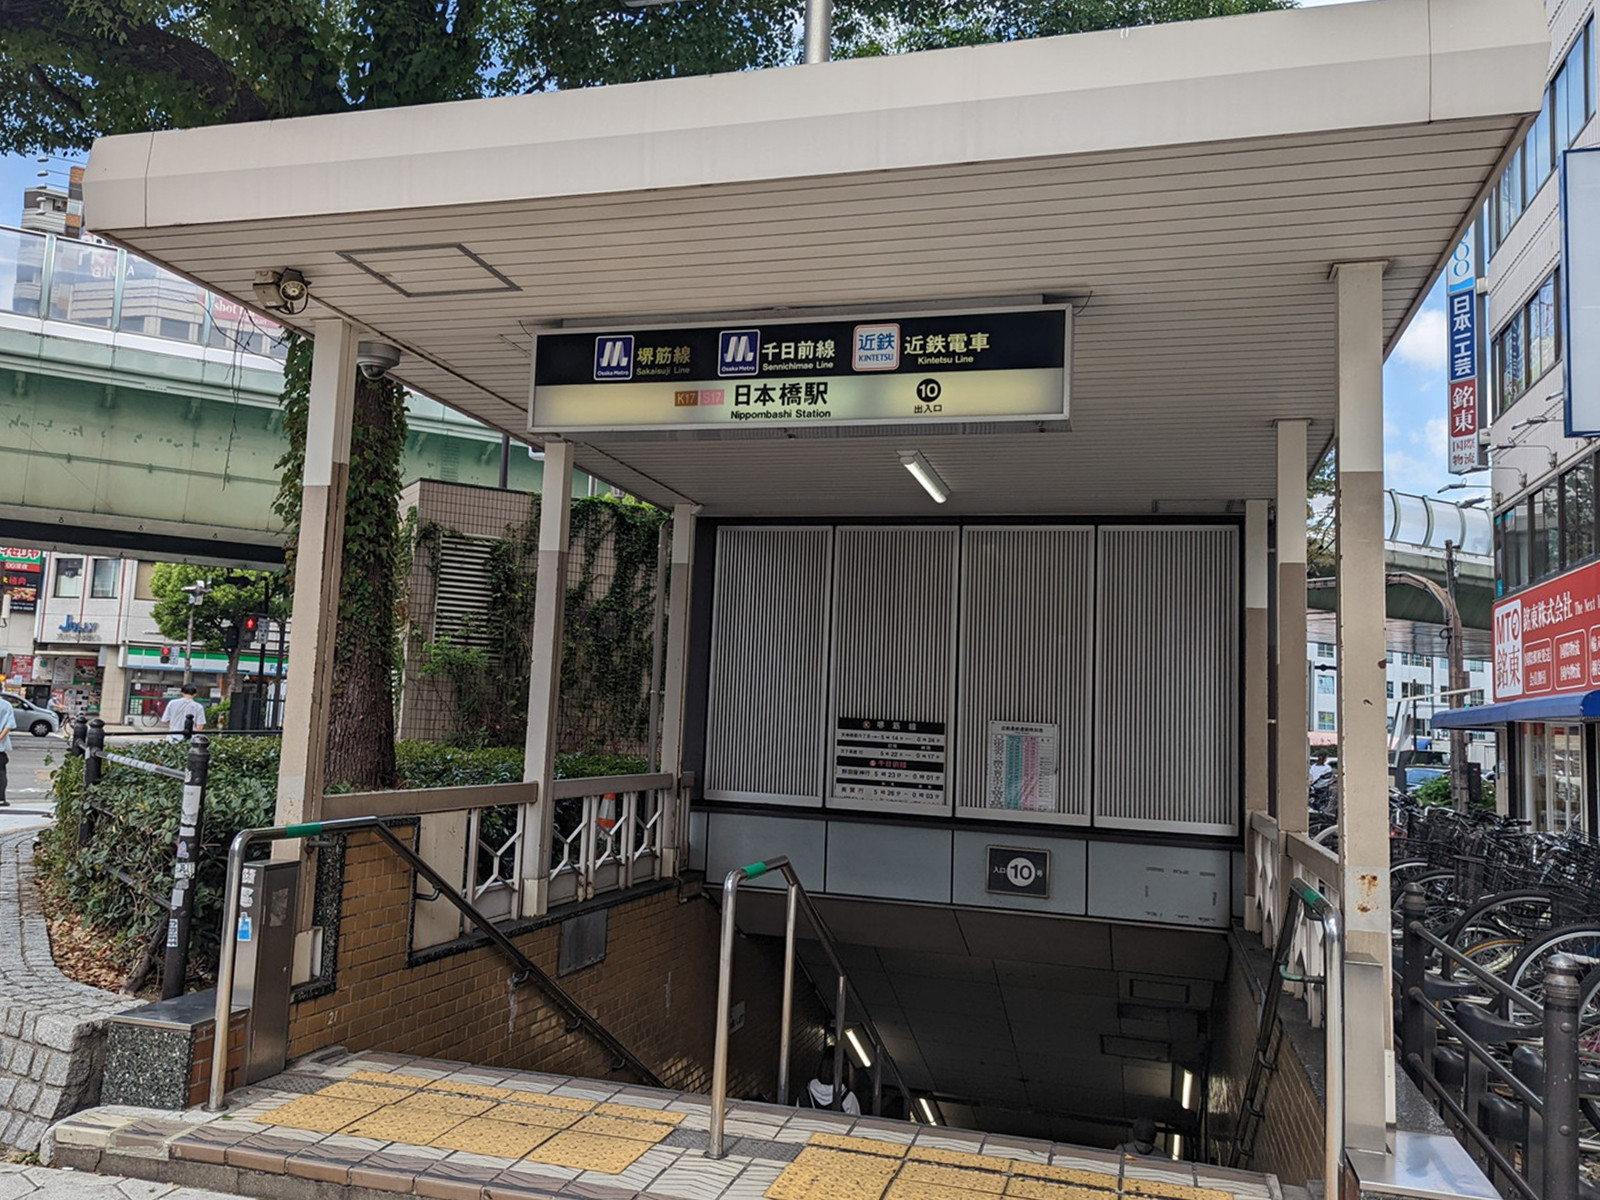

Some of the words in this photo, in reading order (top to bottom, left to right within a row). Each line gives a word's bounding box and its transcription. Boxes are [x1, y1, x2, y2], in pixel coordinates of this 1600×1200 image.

[91, 264, 136, 278] GINA
[214, 299, 237, 314] shot
[858, 333, 895, 351] 近鉄
[1453, 295, 1472, 376] 日本一工芸
[762, 339, 836, 361] 千日前線
[904, 332, 990, 355] 近鉄電車
[636, 346, 691, 366] 堺筋線
[858, 353, 894, 363] KINTETSU
[918, 356, 953, 366] Kintetsu
[955, 355, 974, 364] Line
[636, 367, 671, 377] Sakaisuji
[673, 366, 690, 375] Line
[721, 365, 738, 373] Osaka
[739, 364, 755, 373] Metro
[762, 361, 814, 372] Sennichimae
[816, 360, 834, 370] Line
[734, 381, 828, 407] 日本橋駅
[918, 383, 939, 398] 10
[677, 393, 696, 405] K17
[702, 392, 722, 404] S17
[730, 410, 792, 420] Nippombashi
[795, 409, 831, 418] Station
[913, 403, 943, 414] 出入口
[1453, 385, 1474, 432] 銘東
[1452, 439, 1475, 452] 国際
[1452, 452, 1475, 465] 物流
[1523, 591, 1573, 632] 銘東株式会社
[1497, 645, 1520, 688] 銘東
[993, 866, 1006, 874] 入口
[1010, 864, 1032, 880] 10
